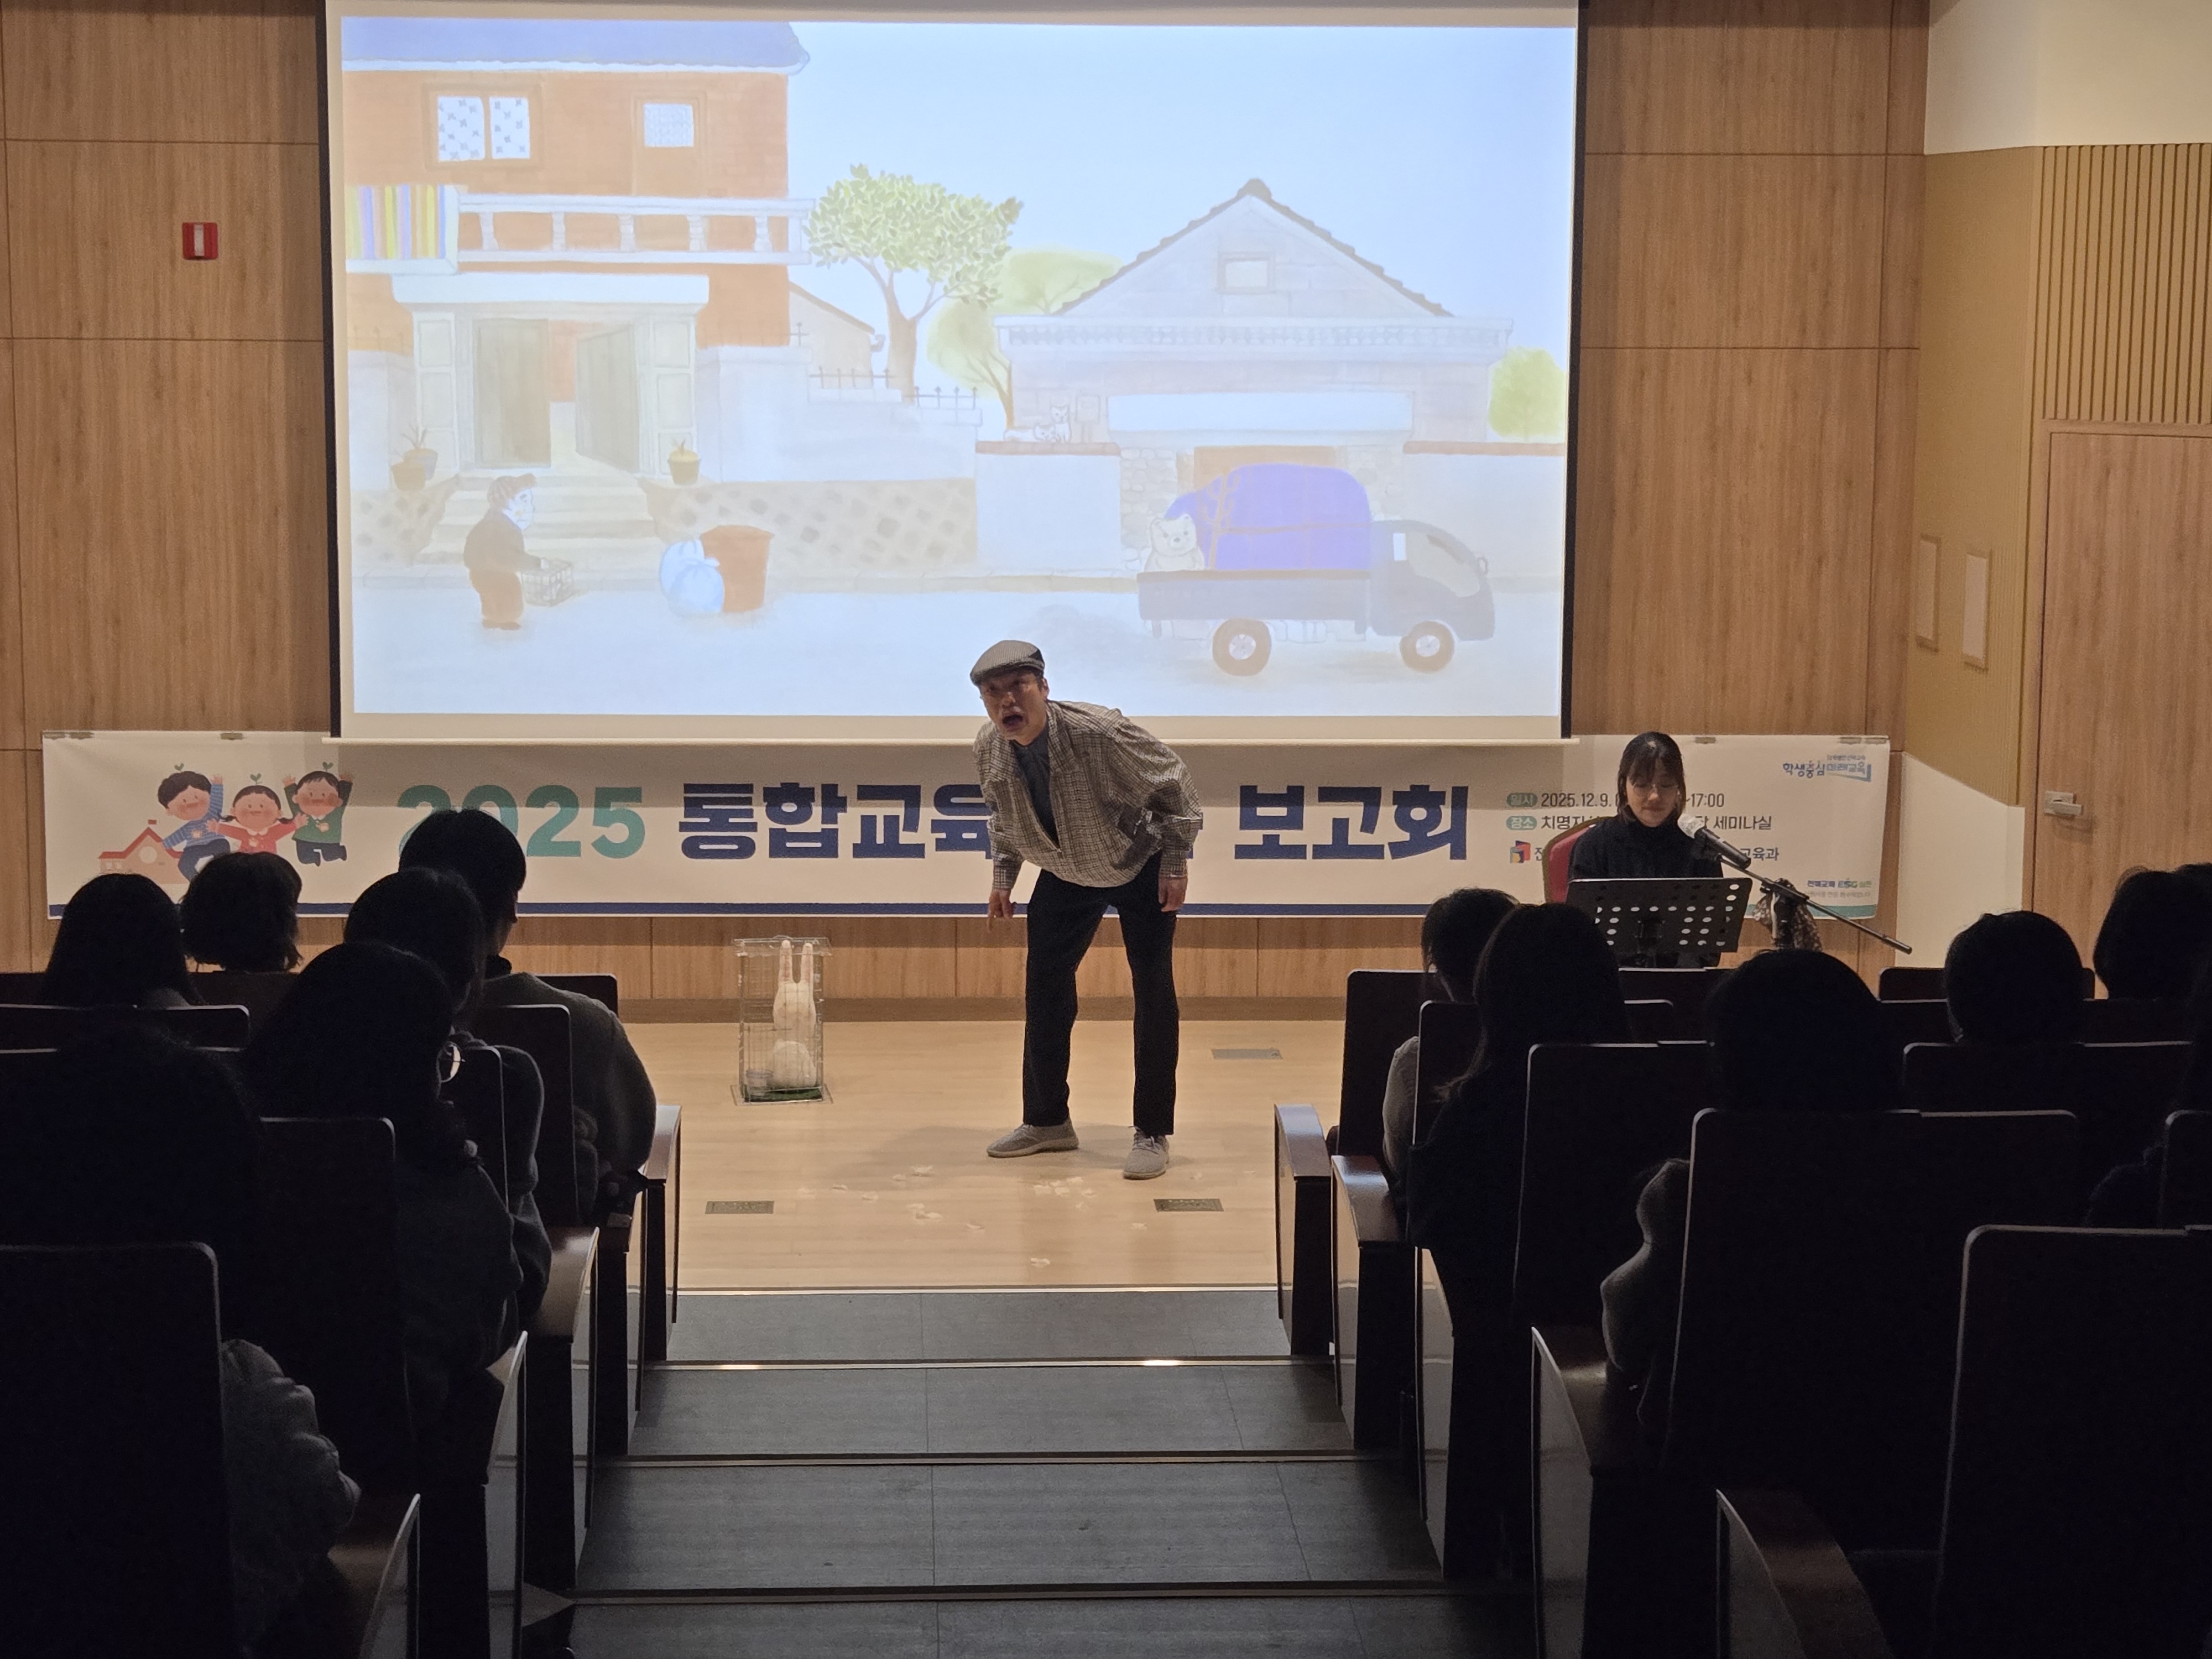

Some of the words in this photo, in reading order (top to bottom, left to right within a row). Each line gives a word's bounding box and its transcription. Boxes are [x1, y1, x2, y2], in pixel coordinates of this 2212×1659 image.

[679, 782, 993, 860] 통합교육
[1234, 784, 1469, 860] 보고회
[1511, 817, 1534, 828] 장소
[1713, 816, 1772, 830] 세미나실
